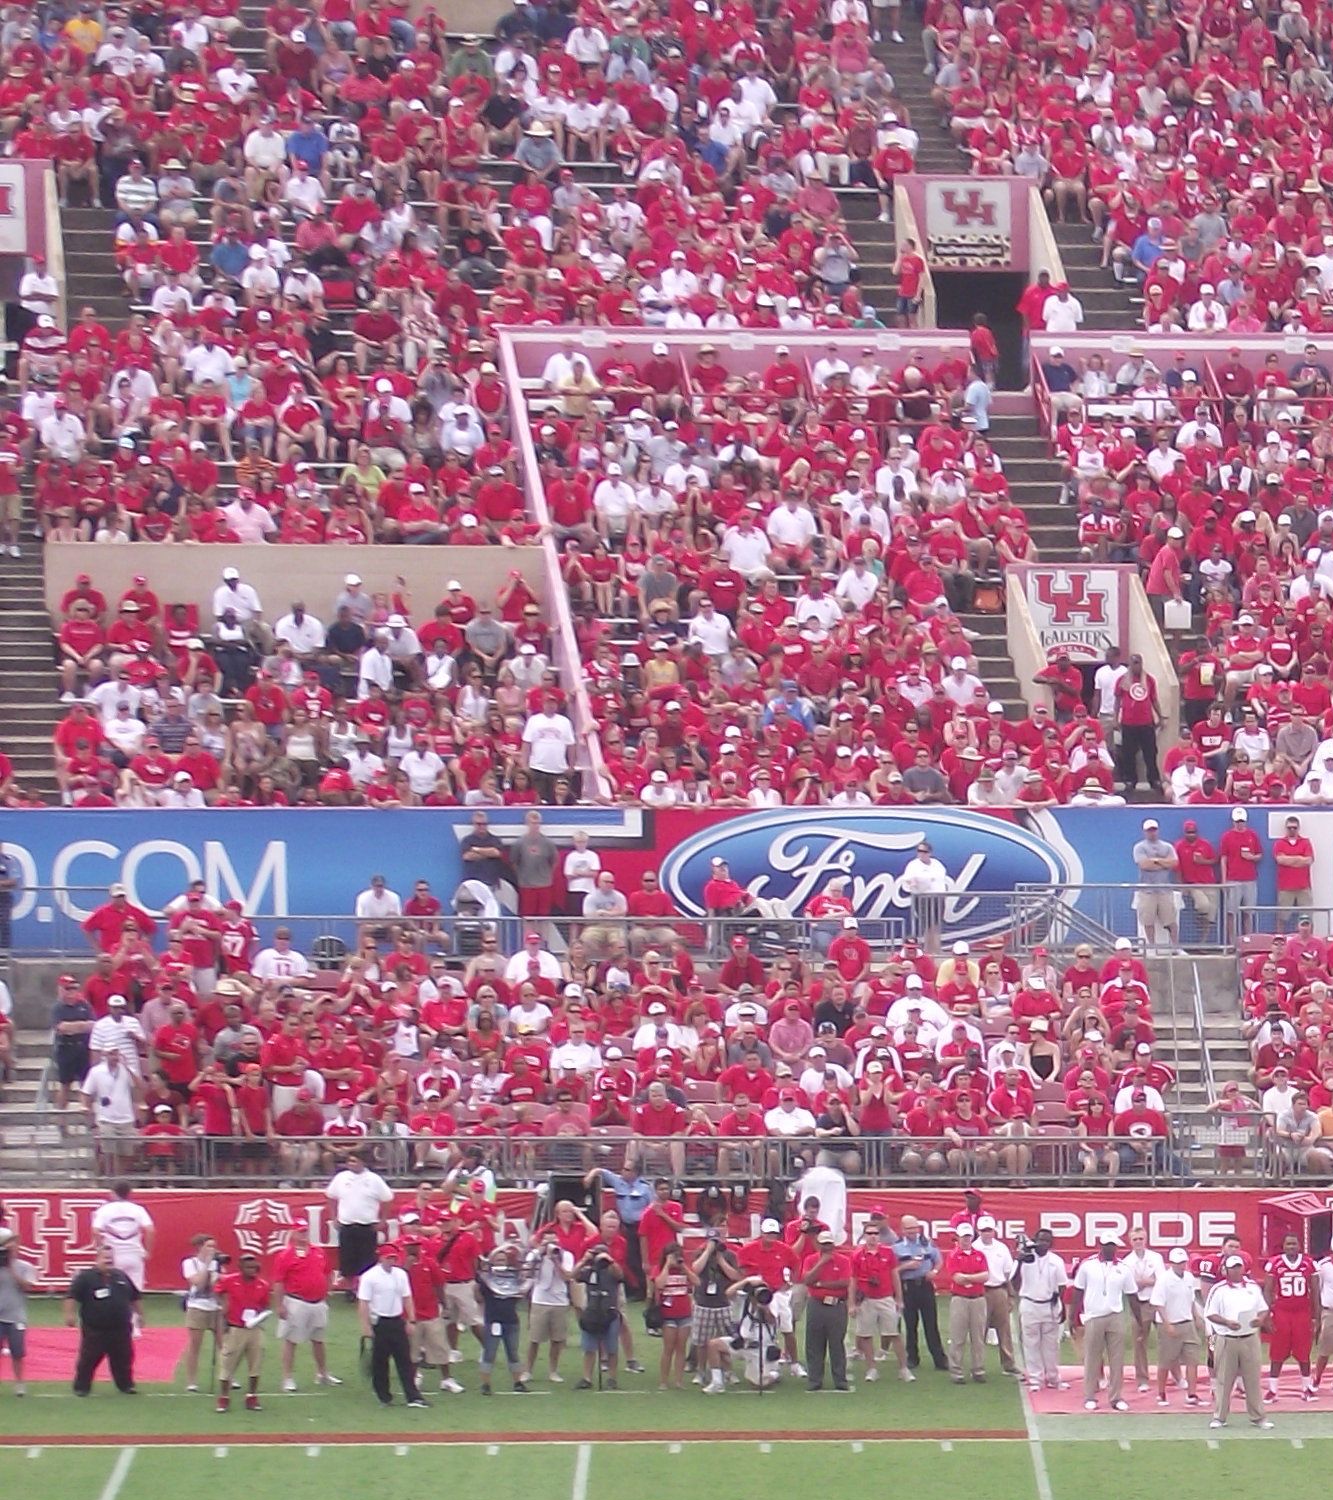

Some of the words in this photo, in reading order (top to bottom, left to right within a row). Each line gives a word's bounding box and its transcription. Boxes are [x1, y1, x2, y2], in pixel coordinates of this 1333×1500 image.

[1034, 573, 1107, 624] UH
[746, 825, 987, 924] Ford
[1040, 1211, 1237, 1248] PRIDE
[1280, 1280, 1306, 1297] 50
